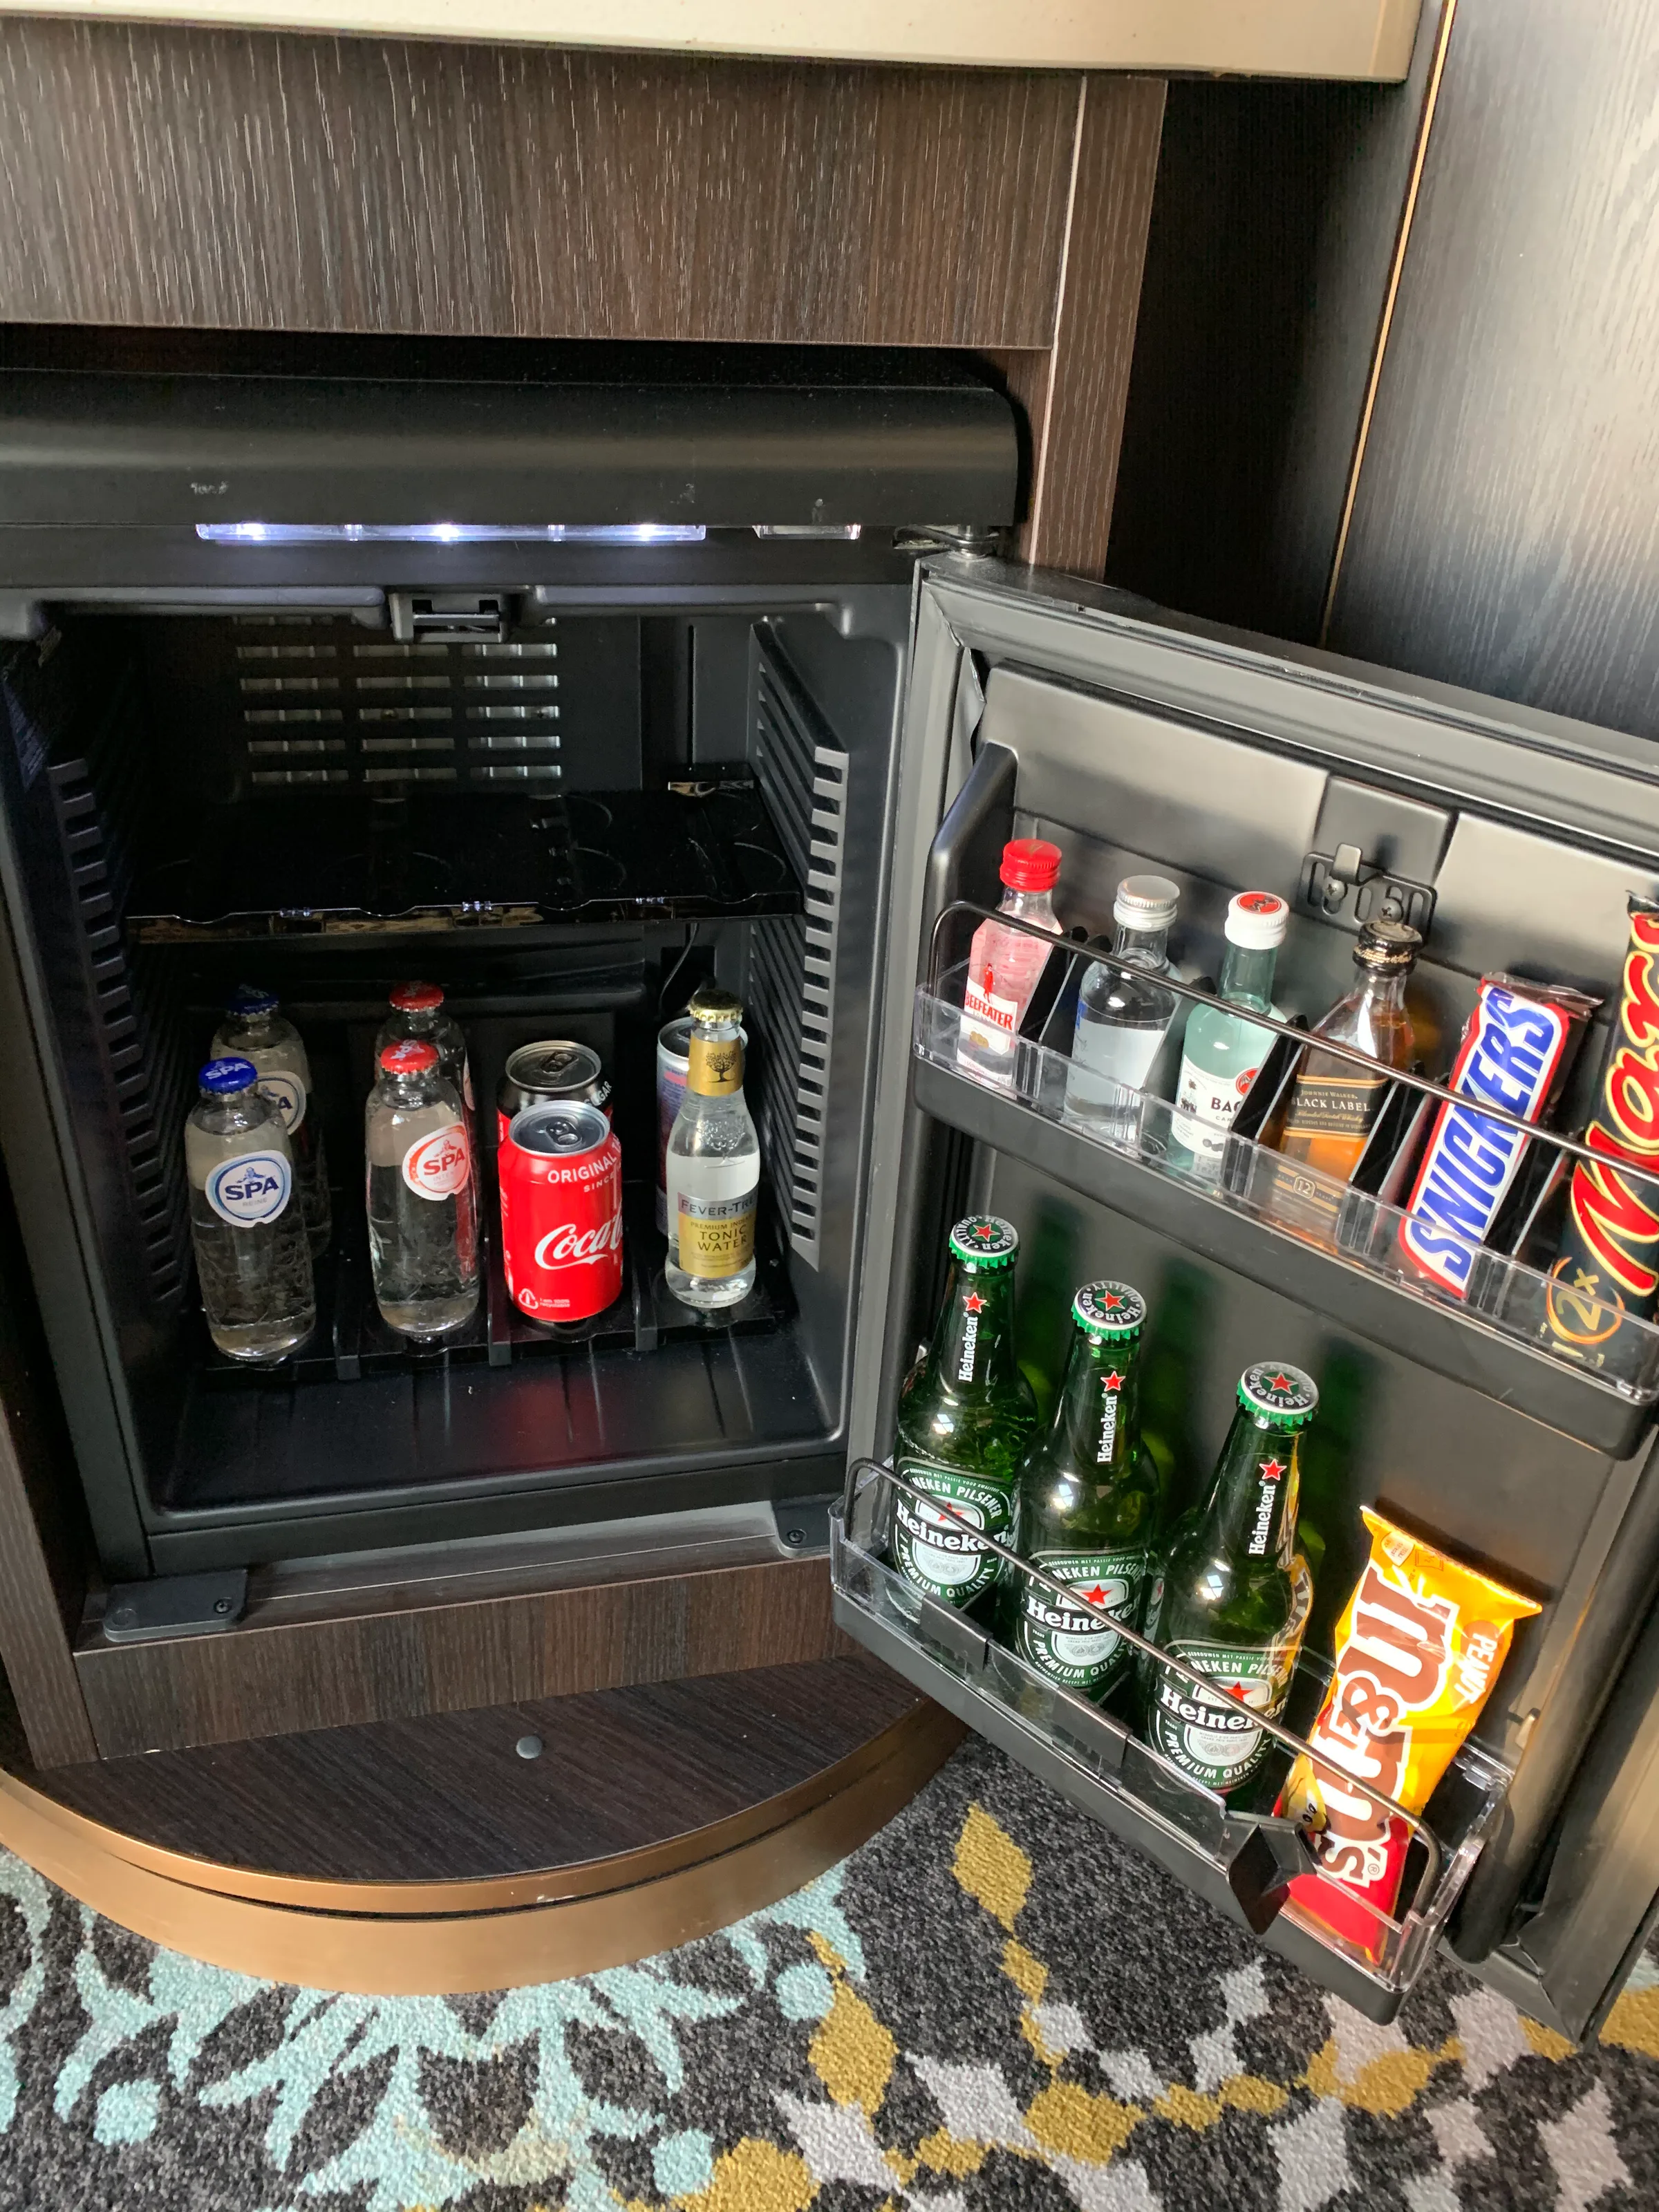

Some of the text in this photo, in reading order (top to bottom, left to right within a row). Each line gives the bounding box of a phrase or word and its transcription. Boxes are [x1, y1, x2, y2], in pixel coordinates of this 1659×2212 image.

[965, 990, 1013, 1031] BEEFEATER
[205, 1062, 251, 1080] SPA
[1331, 1100, 1371, 1112] LABEL
[1410, 987, 1555, 1282] SNICKERS
[422, 1148, 465, 1176] SPA
[547, 1152, 617, 1184] ORIGINAL
[224, 1177, 279, 1201] SPA
[1297, 1179, 1312, 1194] 12
[691, 1221, 728, 1230] PREMIUM
[700, 1224, 747, 1241] TONIC
[955, 1215, 1012, 1250] Heineken QUALITY
[697, 1235, 747, 1252] WATER
[1082, 1293, 1142, 1324] Heineken
[958, 1316, 978, 1382] Heineken
[1249, 1368, 1310, 1407] Heineken
[1097, 1395, 1117, 1463] Heineken
[956, 1485, 1002, 1519] PILSENER
[1248, 1484, 1276, 1555] Heineken
[899, 1543, 941, 1597] PREMIUM
[946, 1567, 995, 1598] QUALITY
[1033, 1639, 1085, 1679] PREMIUM
[1454, 1632, 1499, 1703] PEANUT
[1165, 1731, 1272, 1779] PREMIUM QUALITY
